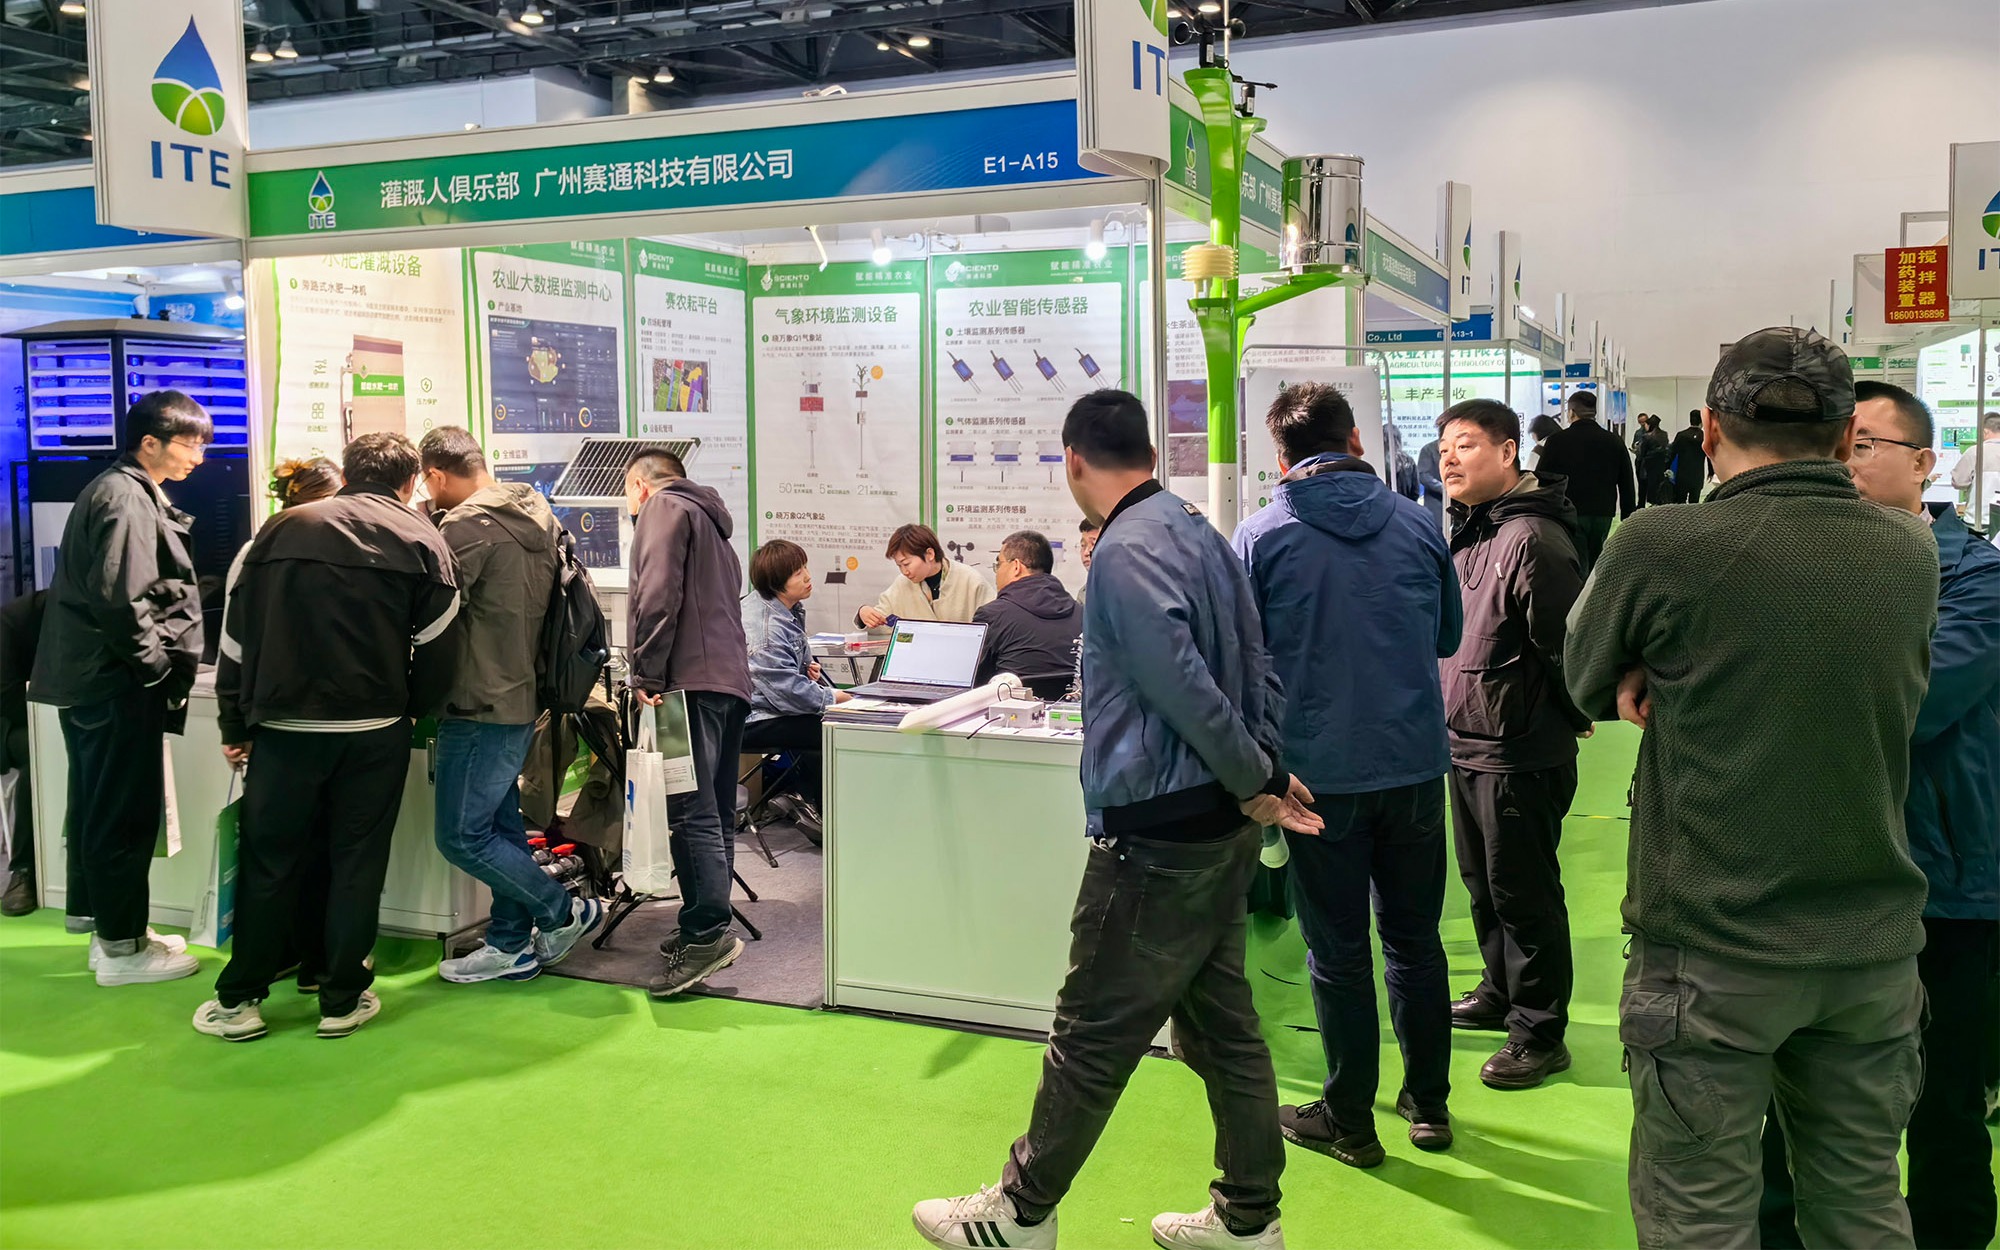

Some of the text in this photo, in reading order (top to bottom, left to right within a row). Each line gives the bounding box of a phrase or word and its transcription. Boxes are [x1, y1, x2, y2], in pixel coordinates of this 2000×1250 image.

[150, 140, 231, 189] ITE
[984, 151, 1059, 174] E1-A15
[380, 149, 793, 209] 灌溉人俱乐部 广州赛通科技有限公司
[308, 213, 336, 229] ITE
[492, 266, 612, 303] 农业大数据监测中心
[774, 274, 809, 283] SCIENTO
[1898, 251, 1916, 308] 加药装置
[1918, 250, 1937, 305] 搅拌器
[665, 291, 718, 316] 赛农耘平台
[968, 296, 1089, 318] 农业智能传感器
[775, 306, 898, 325] 气象环境监测设备
[1889, 309, 1945, 320] 18600136896
[956, 326, 1025, 336] 土壤监测系列传感器
[1388, 333, 1402, 341] Ltd
[1389, 361, 1442, 369] AGRICULTURAL
[957, 417, 1026, 426] 气体监测系列传感器
[779, 483, 792, 494] 50
[957, 505, 1026, 514] 环境监测系列传感器
